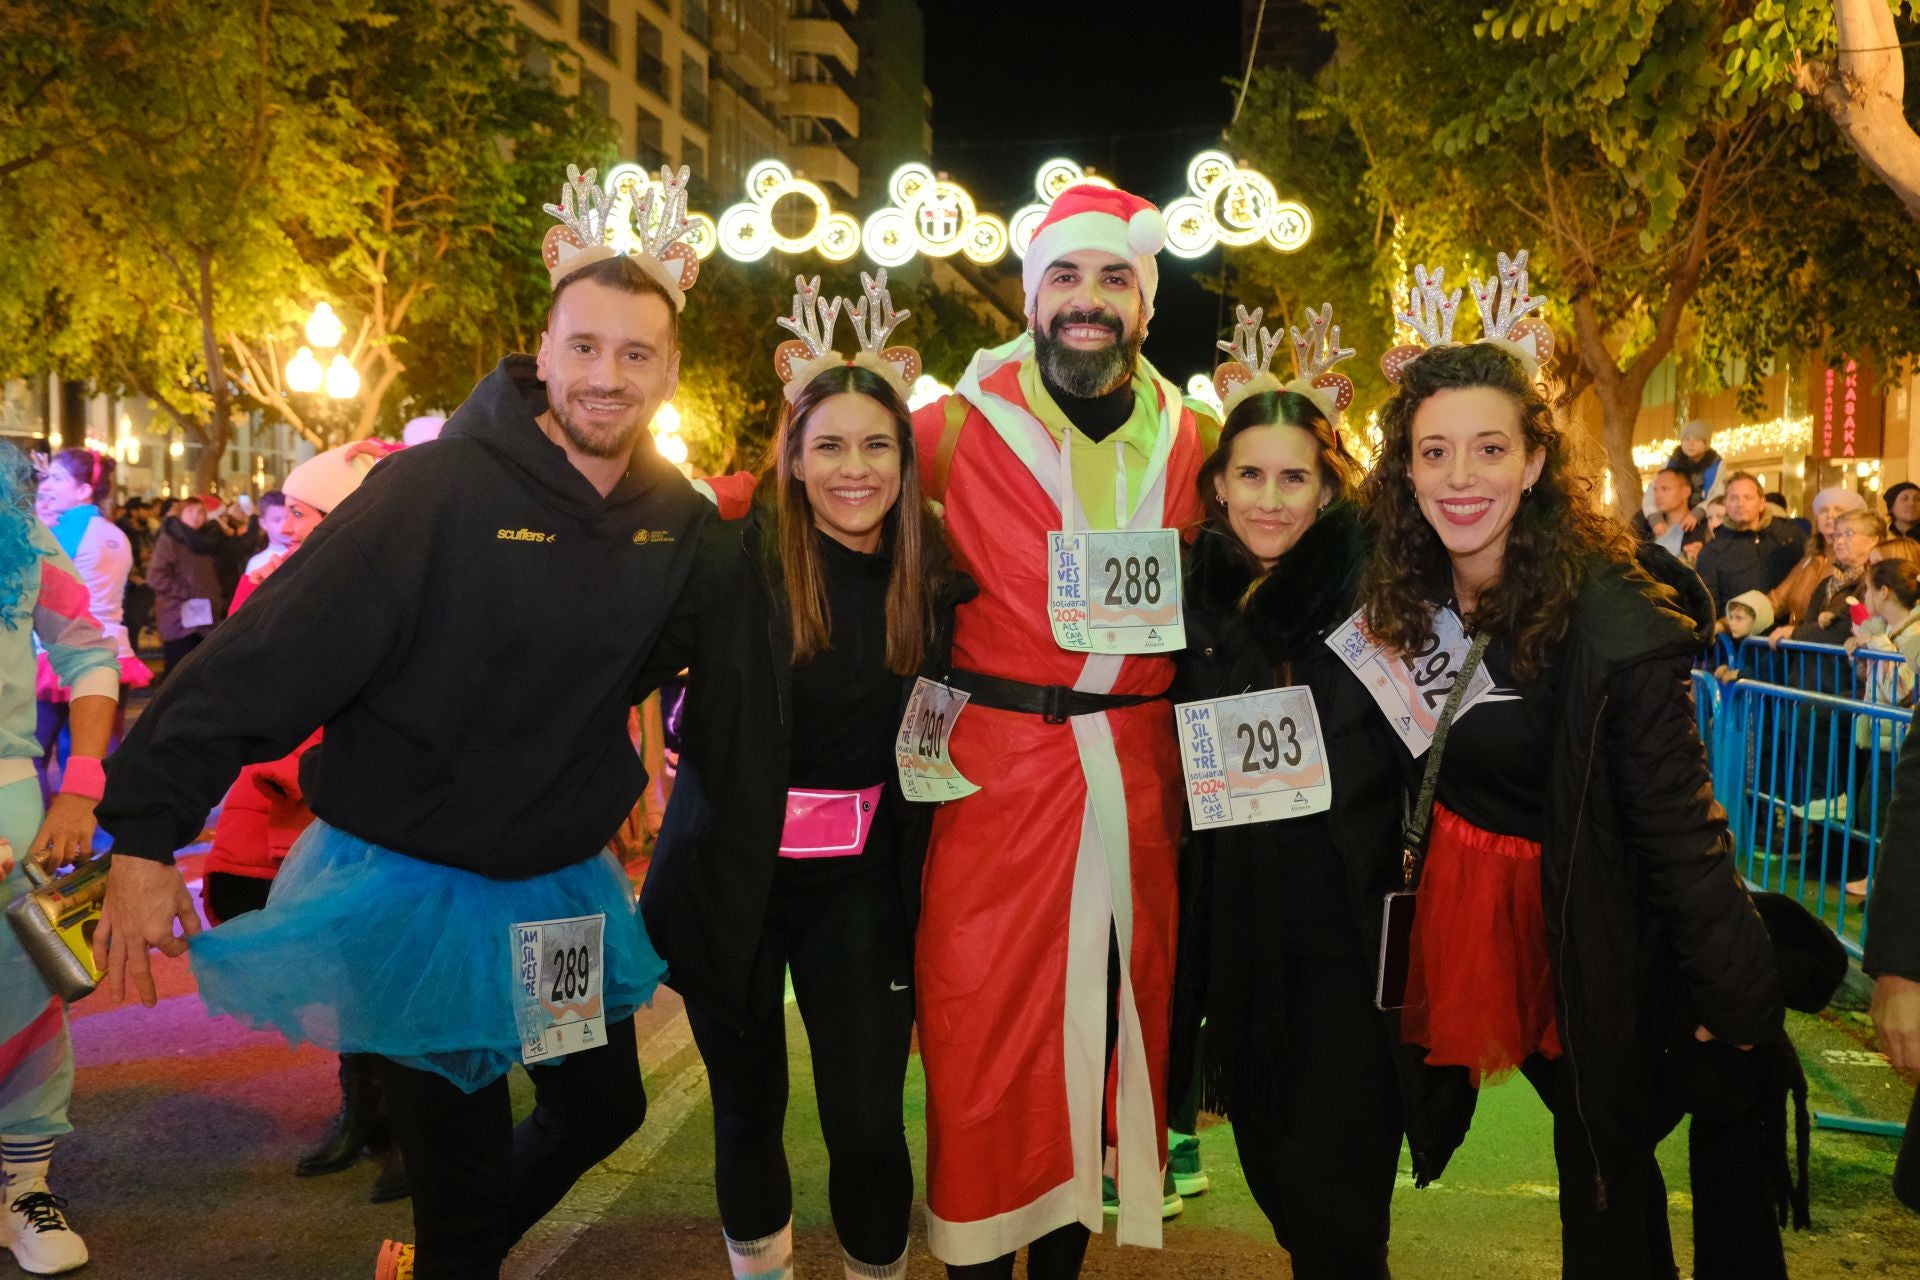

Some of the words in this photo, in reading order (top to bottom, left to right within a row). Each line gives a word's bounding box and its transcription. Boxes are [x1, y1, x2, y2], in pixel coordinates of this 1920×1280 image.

[1823, 368, 1834, 457] ESTAURANTE
[496, 528, 546, 543] scuffers
[1057, 567, 1080, 583] VES
[1104, 556, 1161, 605] 288
[1056, 584, 1081, 598] TRE
[1054, 608, 1087, 622] 2024
[1063, 622, 1079, 631] ALI
[1065, 631, 1082, 640] CAN
[1342, 644, 1358, 662] TE
[1346, 639, 1363, 656] CAN
[1400, 633, 1459, 710] 292
[1184, 708, 1210, 725] SAN
[918, 709, 945, 760] 290
[1192, 737, 1214, 754] VES
[1237, 716, 1302, 773] 293
[1193, 753, 1217, 769] TRE
[1191, 779, 1226, 795] 2024
[1201, 792, 1219, 805] ALI
[1203, 803, 1223, 814] CAN
[1205, 811, 1226, 822] TE
[551, 945, 590, 1002] 289
[530, 1044, 543, 1056] TE
